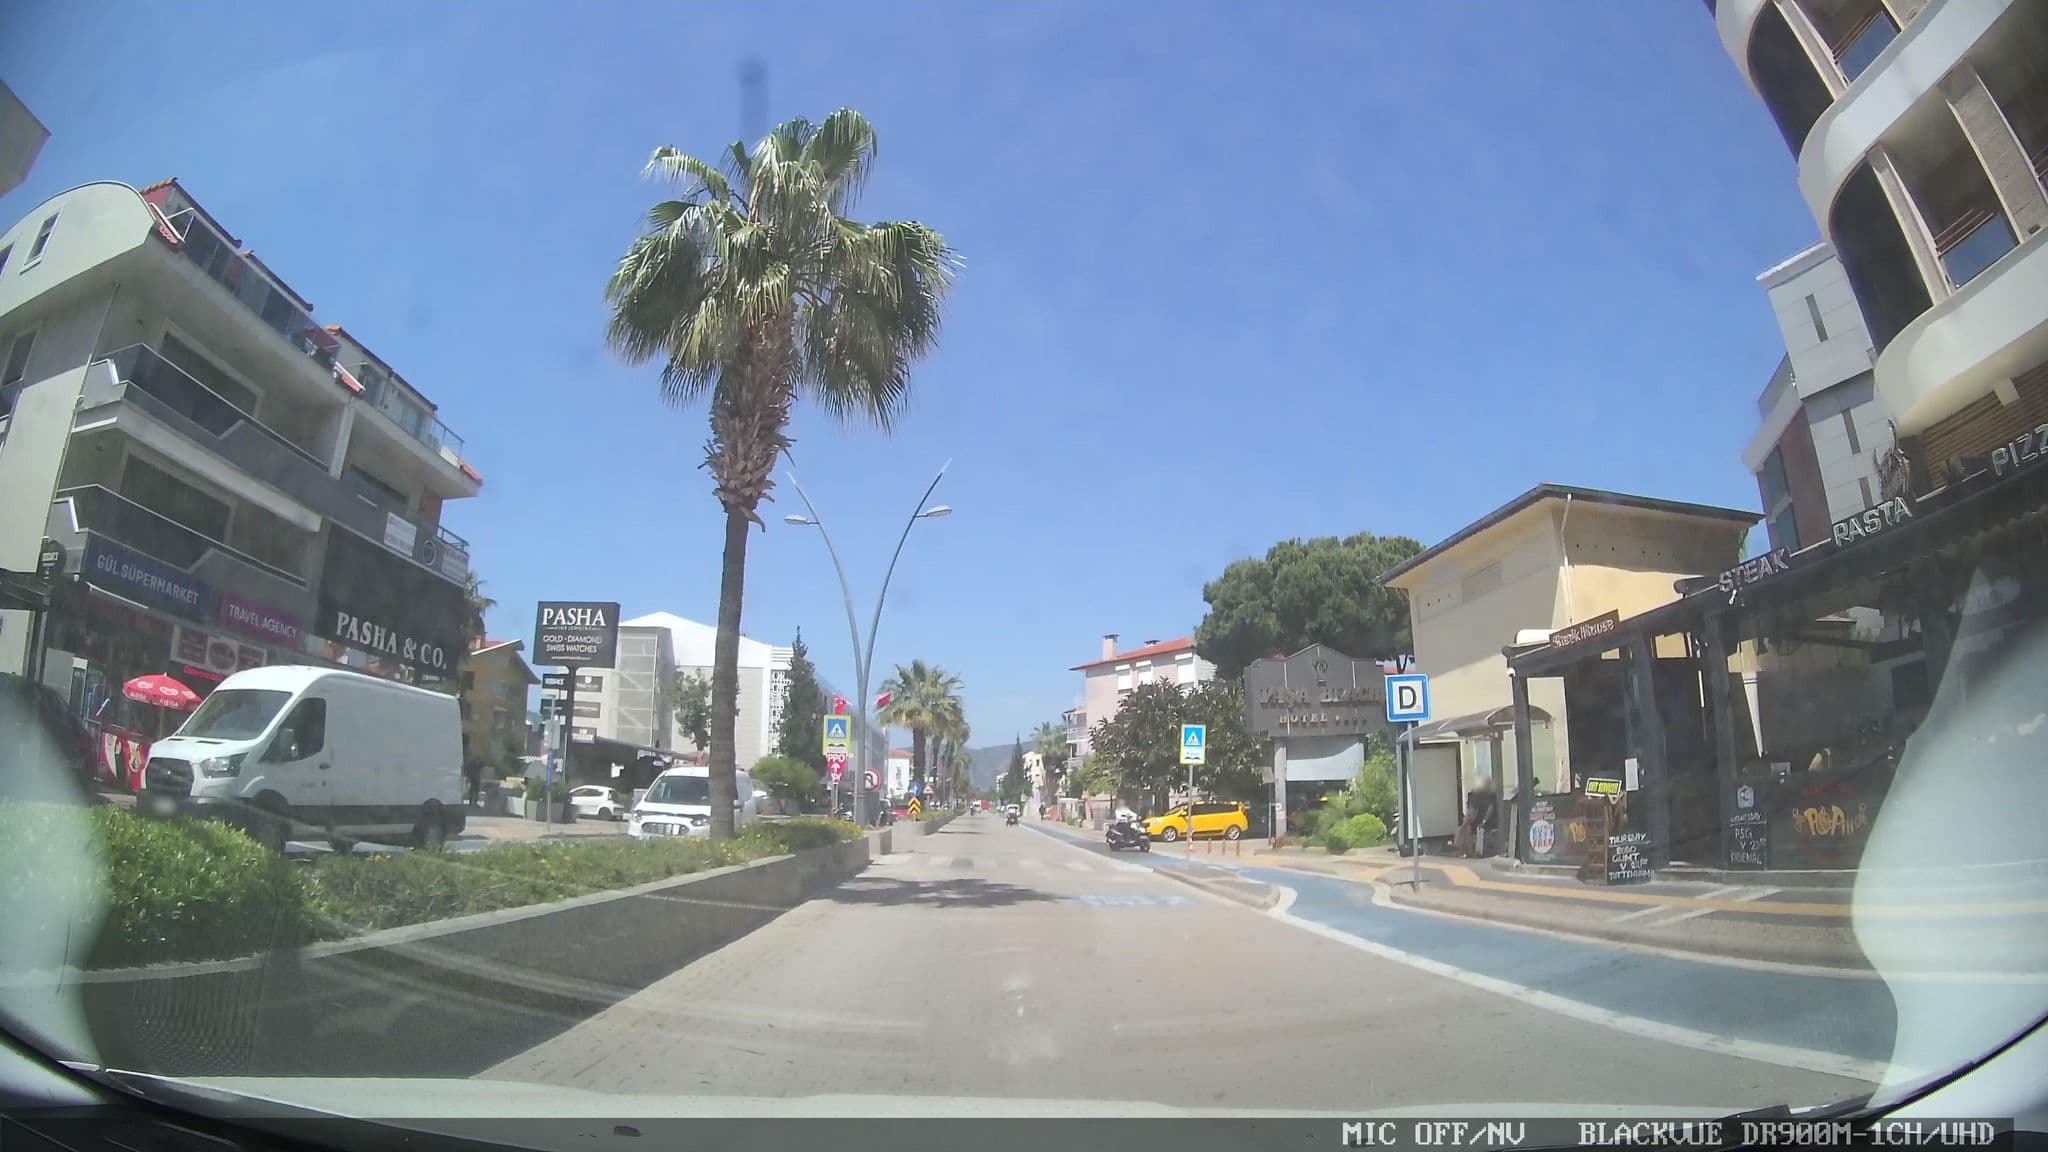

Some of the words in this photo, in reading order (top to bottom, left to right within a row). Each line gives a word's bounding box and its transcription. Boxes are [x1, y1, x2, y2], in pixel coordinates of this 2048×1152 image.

[97, 554, 119, 575] GÜL
[121, 563, 200, 605] SÜPERMARKET
[1718, 547, 1790, 592] STEAK
[229, 604, 258, 626] TRAVEL
[262, 617, 298, 639] AGENCY
[541, 607, 607, 627] PASHA
[335, 611, 397, 654] PASHA
[403, 637, 418, 660] &
[421, 643, 447, 670] CO.
[543, 635, 563, 643] GOLD
[567, 635, 602, 644] DIAMOND
[546, 644, 565, 652] SWISS
[566, 644, 598, 653] WATCHES
[1398, 685, 1418, 709] D
[1279, 713, 1329, 726] HOTEL
